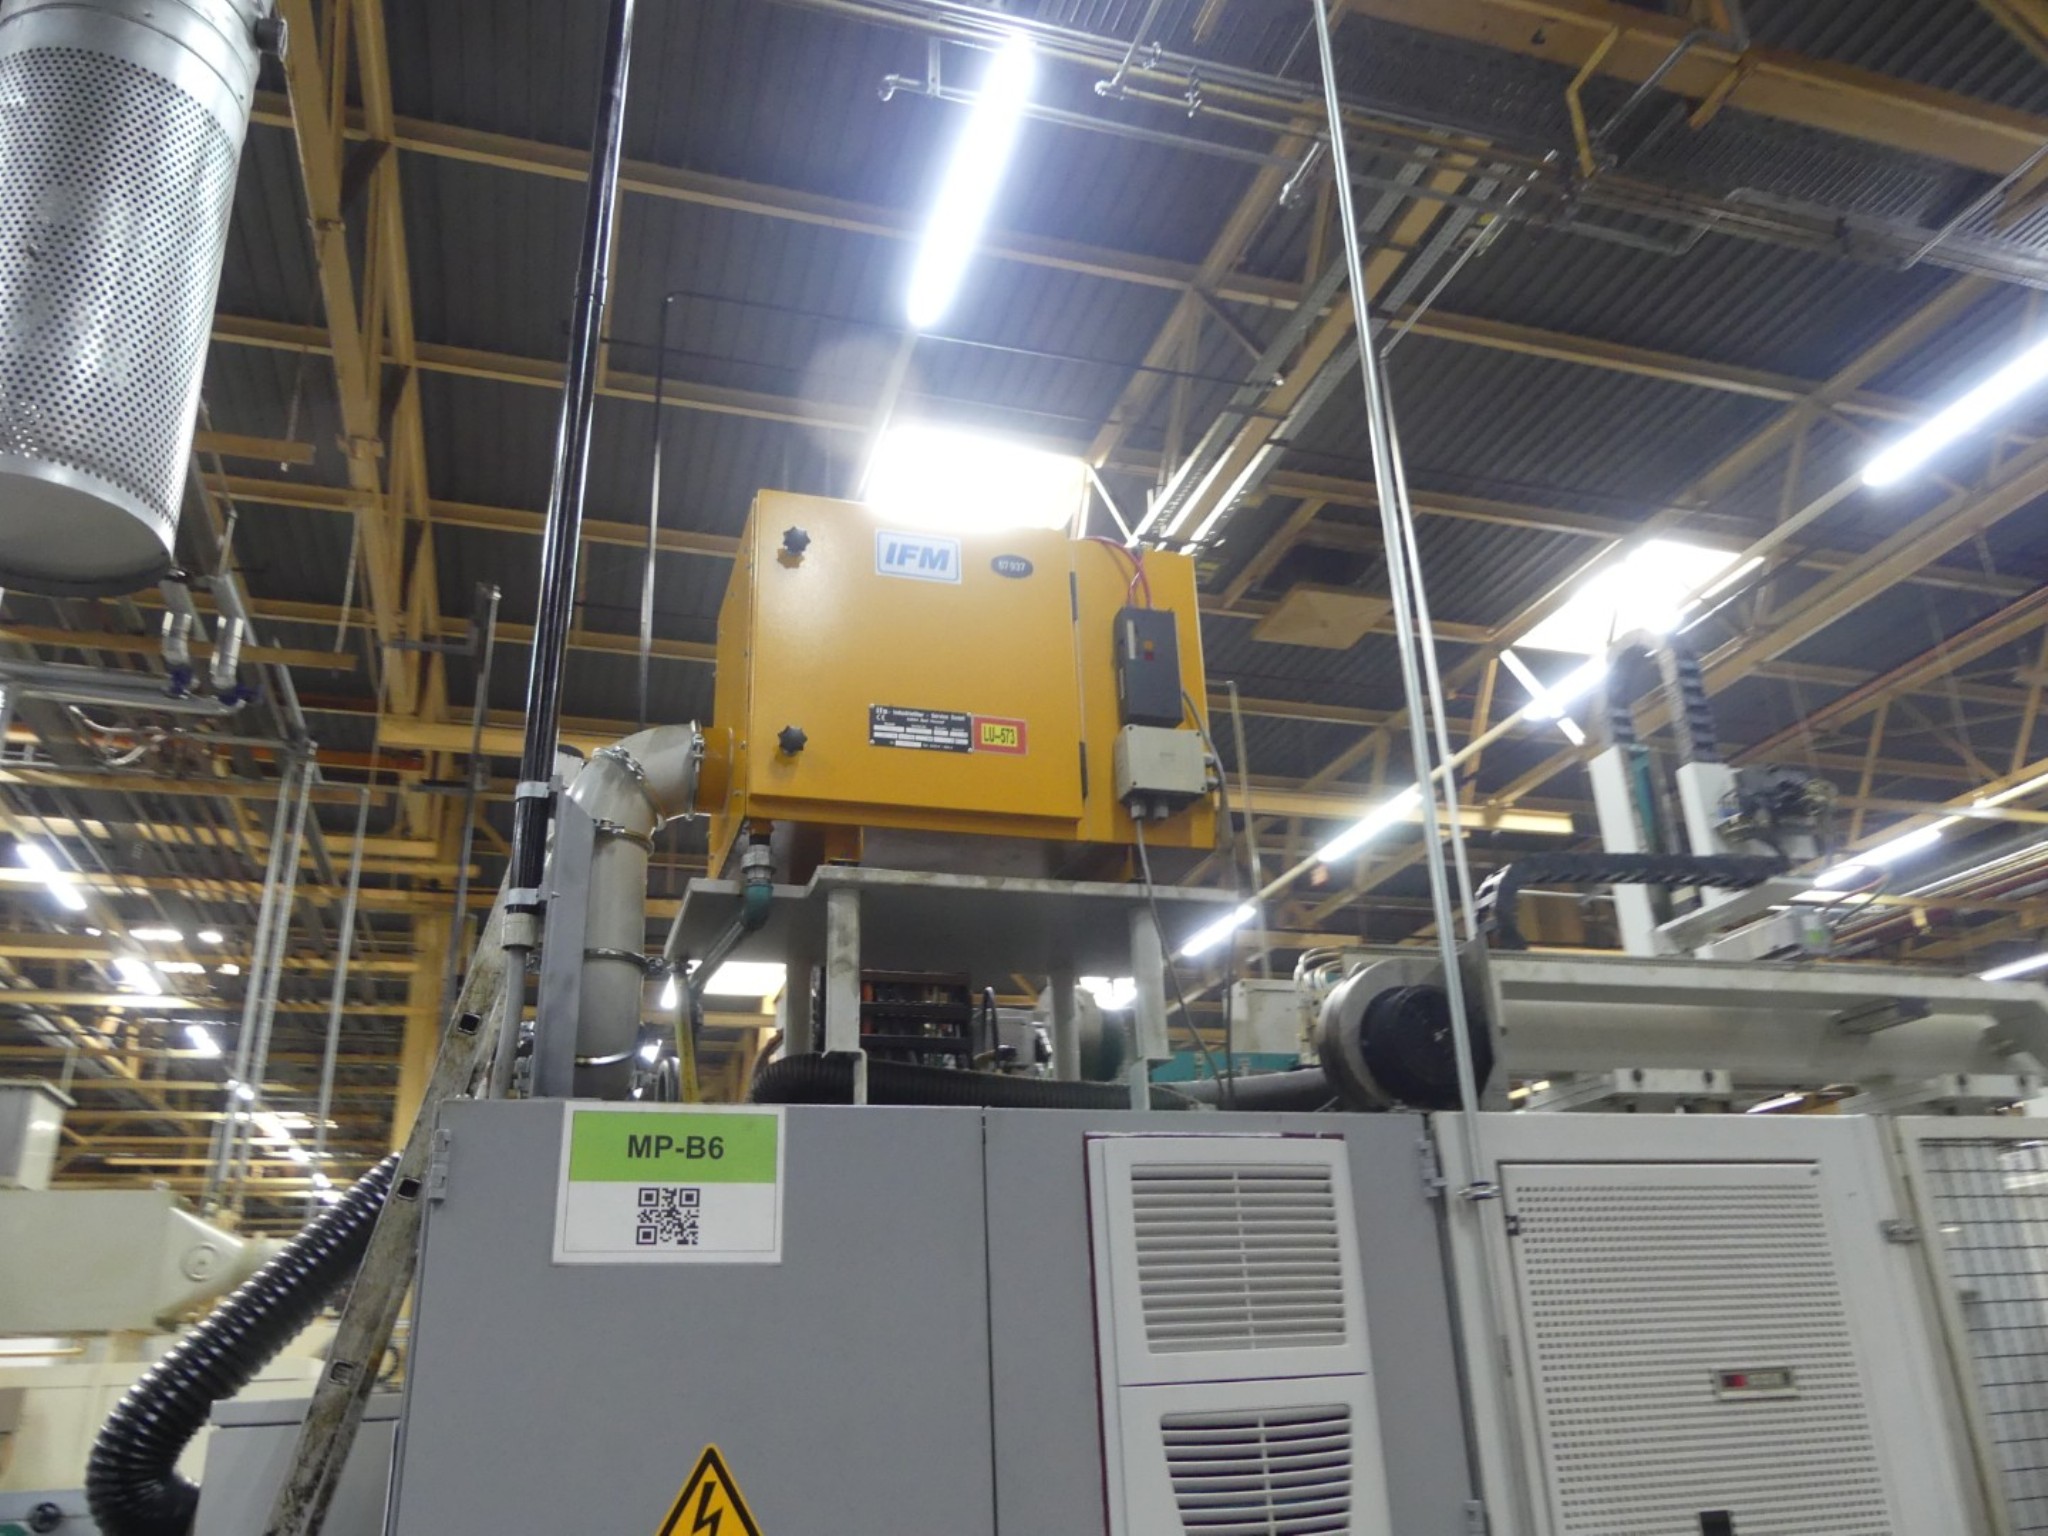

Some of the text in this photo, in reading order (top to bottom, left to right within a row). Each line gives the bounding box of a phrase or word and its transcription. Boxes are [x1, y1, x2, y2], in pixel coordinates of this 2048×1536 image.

[885, 542, 950, 571] IFM
[984, 726, 1015, 744] LU-573
[627, 1134, 724, 1160] MP-B6
